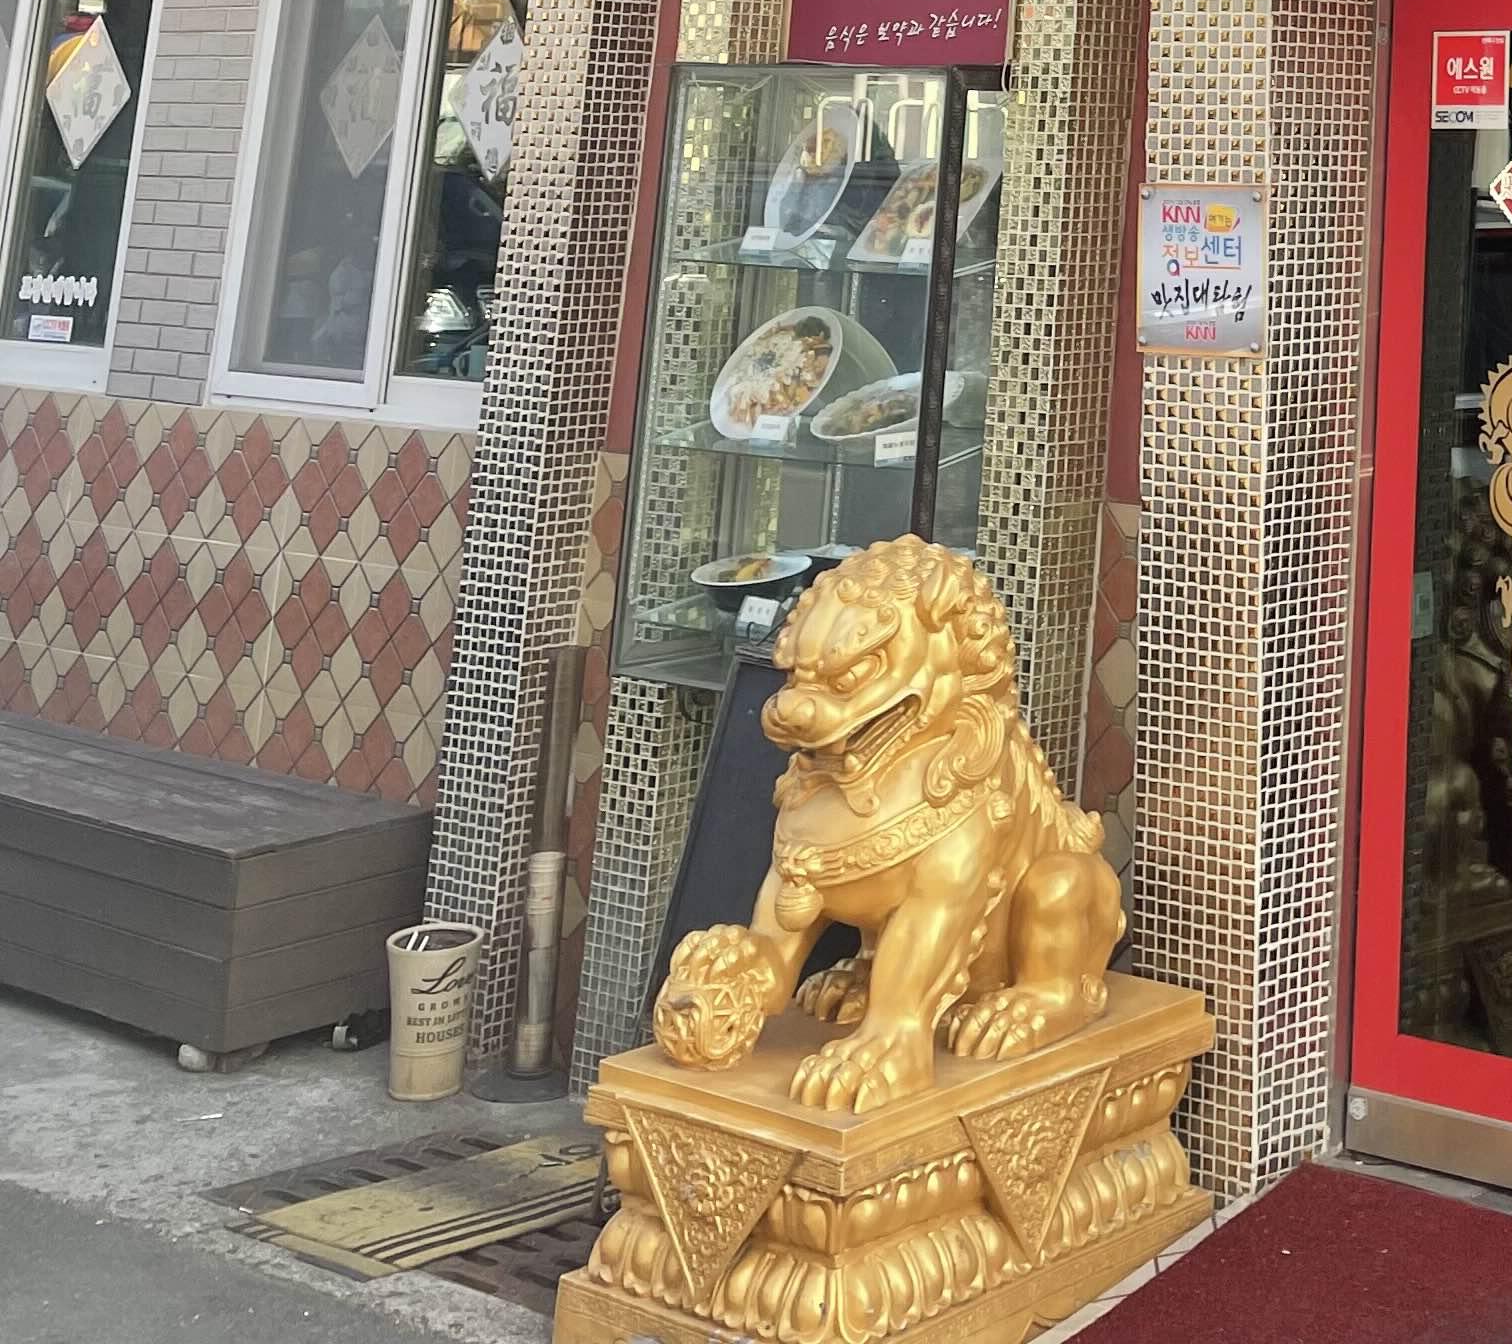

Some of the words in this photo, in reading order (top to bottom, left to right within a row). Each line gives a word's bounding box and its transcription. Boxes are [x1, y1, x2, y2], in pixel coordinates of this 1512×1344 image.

[825, 23, 869, 52] 음식은
[877, 20, 924, 46] 보약과
[929, 8, 1002, 40] 같습니다!
[1446, 56, 1493, 80] 에스원
[1435, 111, 1474, 122] SECOM
[1162, 205, 1200, 223] KNN
[1162, 224, 1200, 242] 생방송
[1185, 325, 1216, 341] KNN
